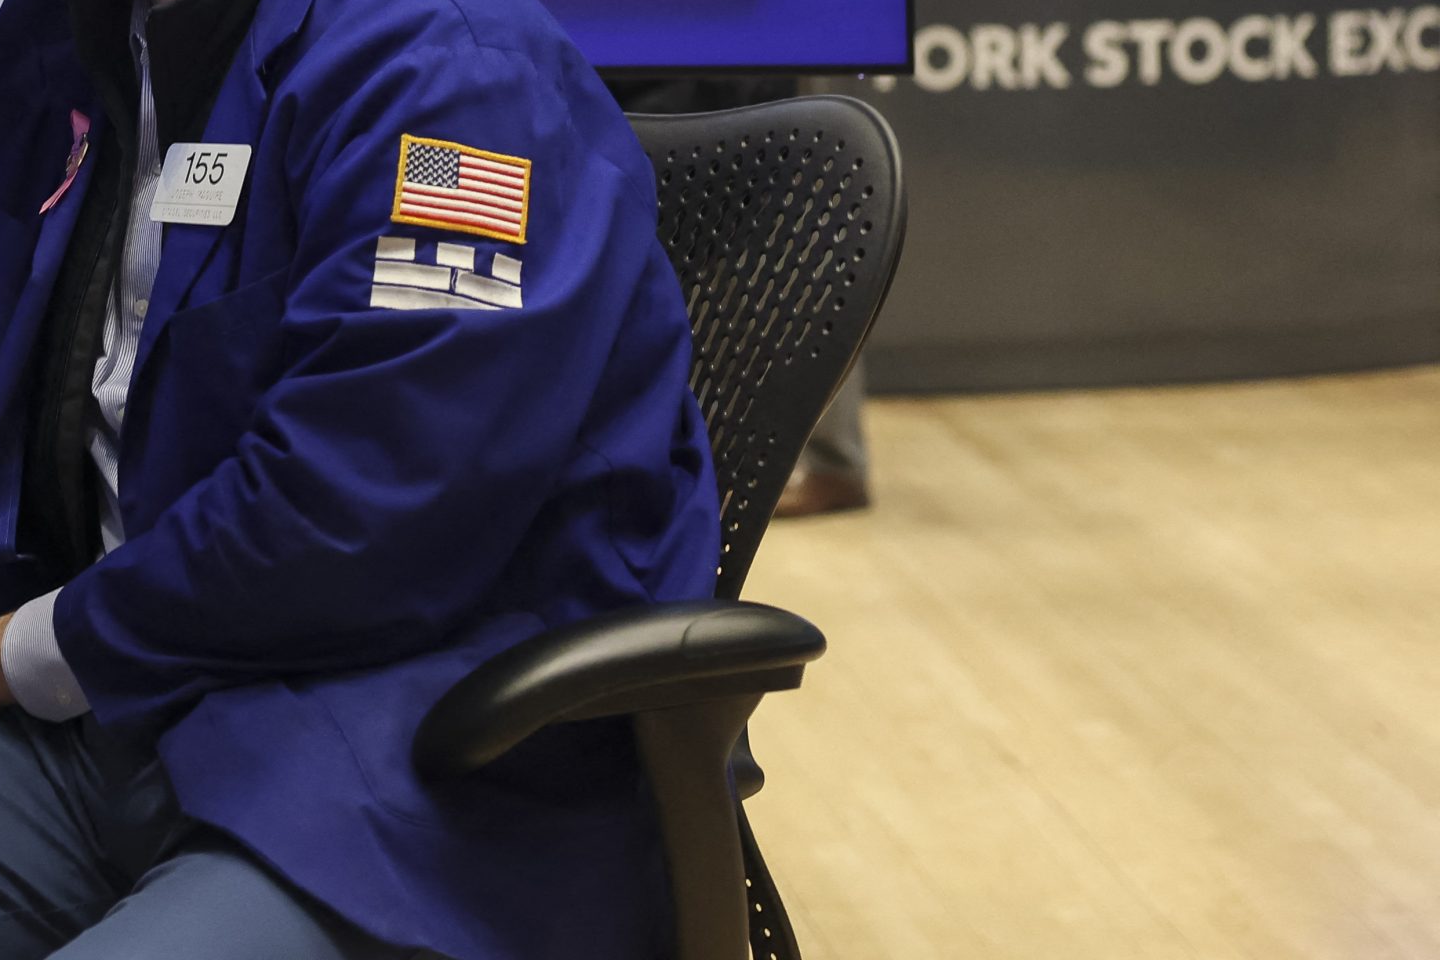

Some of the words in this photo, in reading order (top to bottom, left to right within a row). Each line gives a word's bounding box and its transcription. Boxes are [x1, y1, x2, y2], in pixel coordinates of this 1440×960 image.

[872, 22, 1071, 92] ORK
[1082, 12, 1317, 88] STOCK
[1327, 4, 1440, 78] EXC
[184, 151, 228, 185] 155
